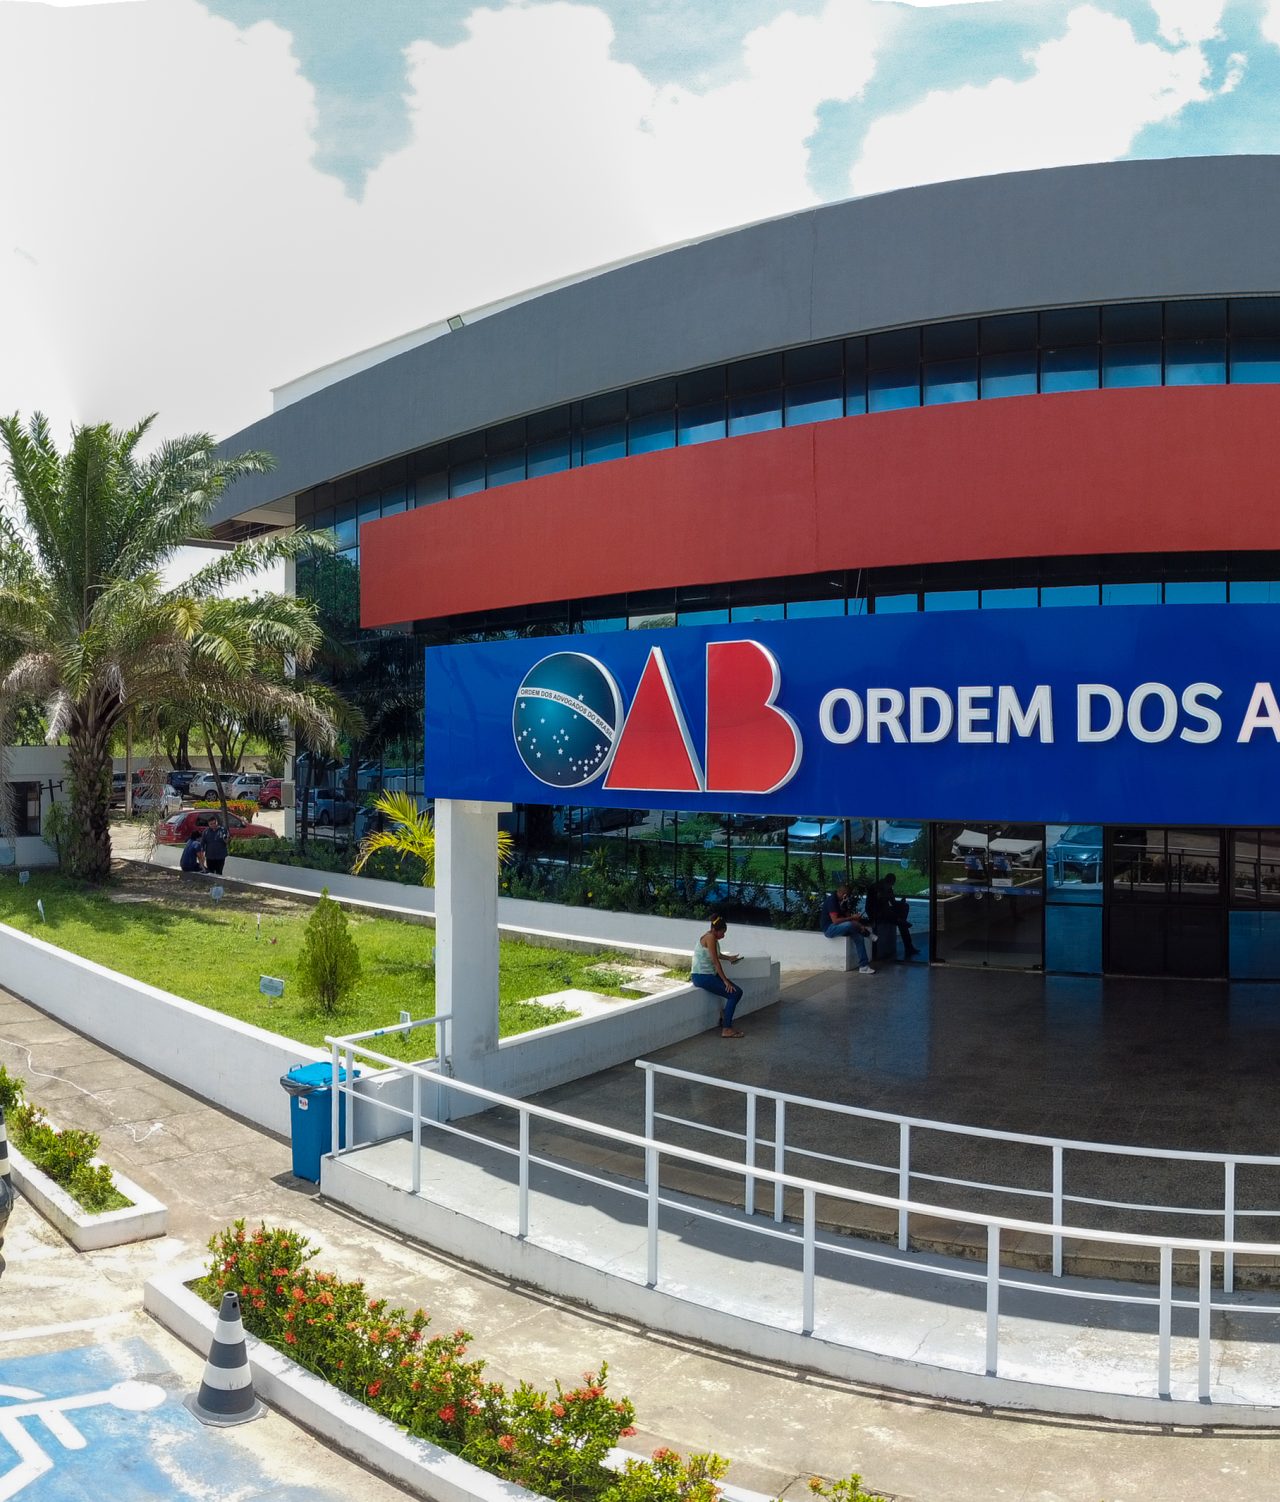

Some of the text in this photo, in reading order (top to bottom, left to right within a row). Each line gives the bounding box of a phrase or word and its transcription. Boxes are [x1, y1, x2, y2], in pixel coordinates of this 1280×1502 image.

[513, 639, 803, 793] OAB
[541, 690, 553, 699] DOS
[553, 693, 587, 715] ADVOGADOS
[587, 710, 596, 721] DO
[595, 718, 613, 739] BRASIL
[819, 685, 1054, 744] ORDEM
[1077, 683, 1223, 744] DOS
